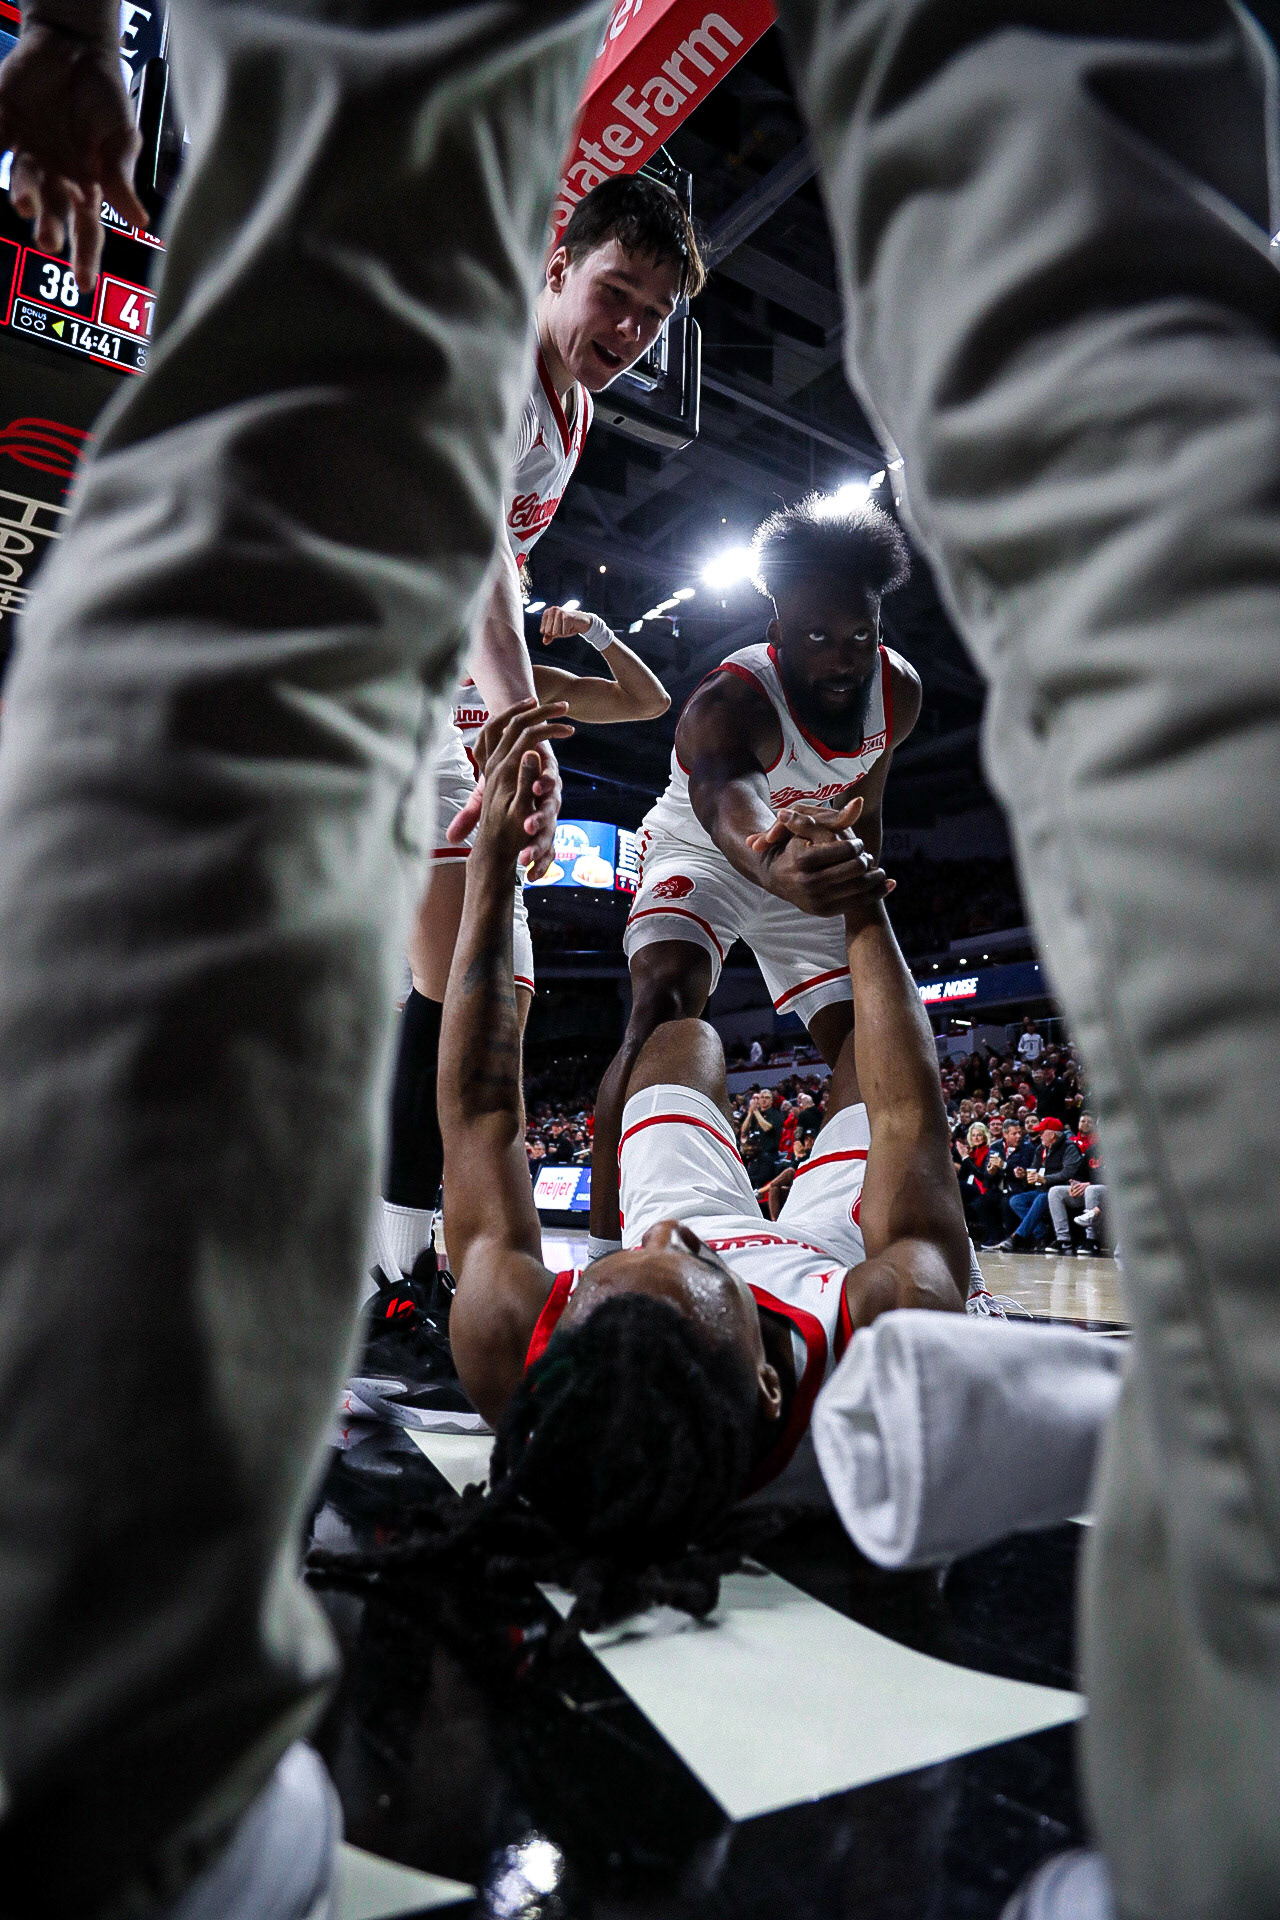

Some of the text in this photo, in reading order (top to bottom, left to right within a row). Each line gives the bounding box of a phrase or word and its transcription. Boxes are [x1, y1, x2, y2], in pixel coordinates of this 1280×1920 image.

[39, 263, 79, 307] 38
[21, 305, 47, 321] BONUS
[119, 293, 156, 336] 41
[70, 321, 121, 360] 14:41
[918, 977, 978, 1000] OME NOISE
[536, 1177, 572, 1200] meijer
